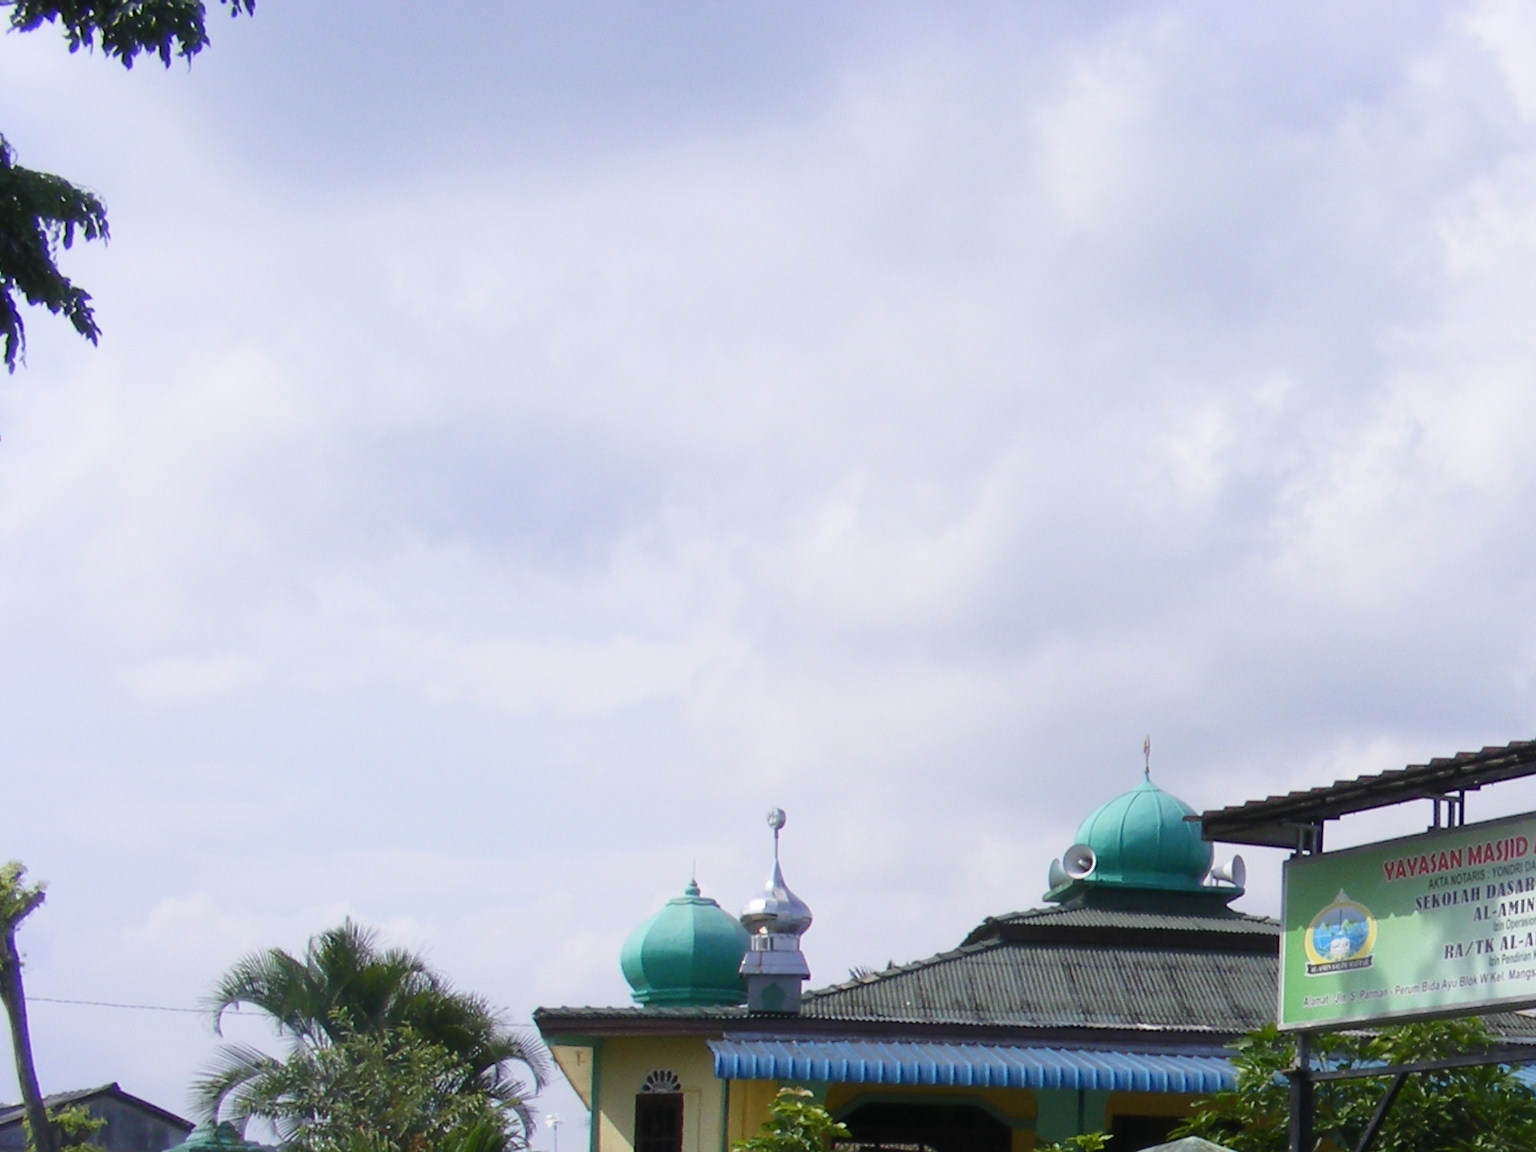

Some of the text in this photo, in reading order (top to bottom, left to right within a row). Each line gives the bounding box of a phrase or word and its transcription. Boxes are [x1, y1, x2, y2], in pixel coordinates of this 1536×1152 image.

[1384, 848, 1462, 881] YAYASAN
[1467, 836, 1529, 867] MASJID
[1428, 876, 1449, 889] AKTA
[1450, 869, 1486, 887] NOTARIS
[1492, 862, 1523, 878] YONDRI
[1415, 886, 1480, 911] SEKOLAH
[1487, 877, 1535, 899] DASAR
[1444, 938, 1495, 960] RA/TK
[1501, 951, 1532, 965] Pendirian
[1395, 983, 1420, 995] Perum
[1422, 980, 1440, 993] Bida
[1441, 978, 1457, 992] Ayu
[1460, 975, 1477, 987] Blok
[1480, 973, 1489, 983] W
